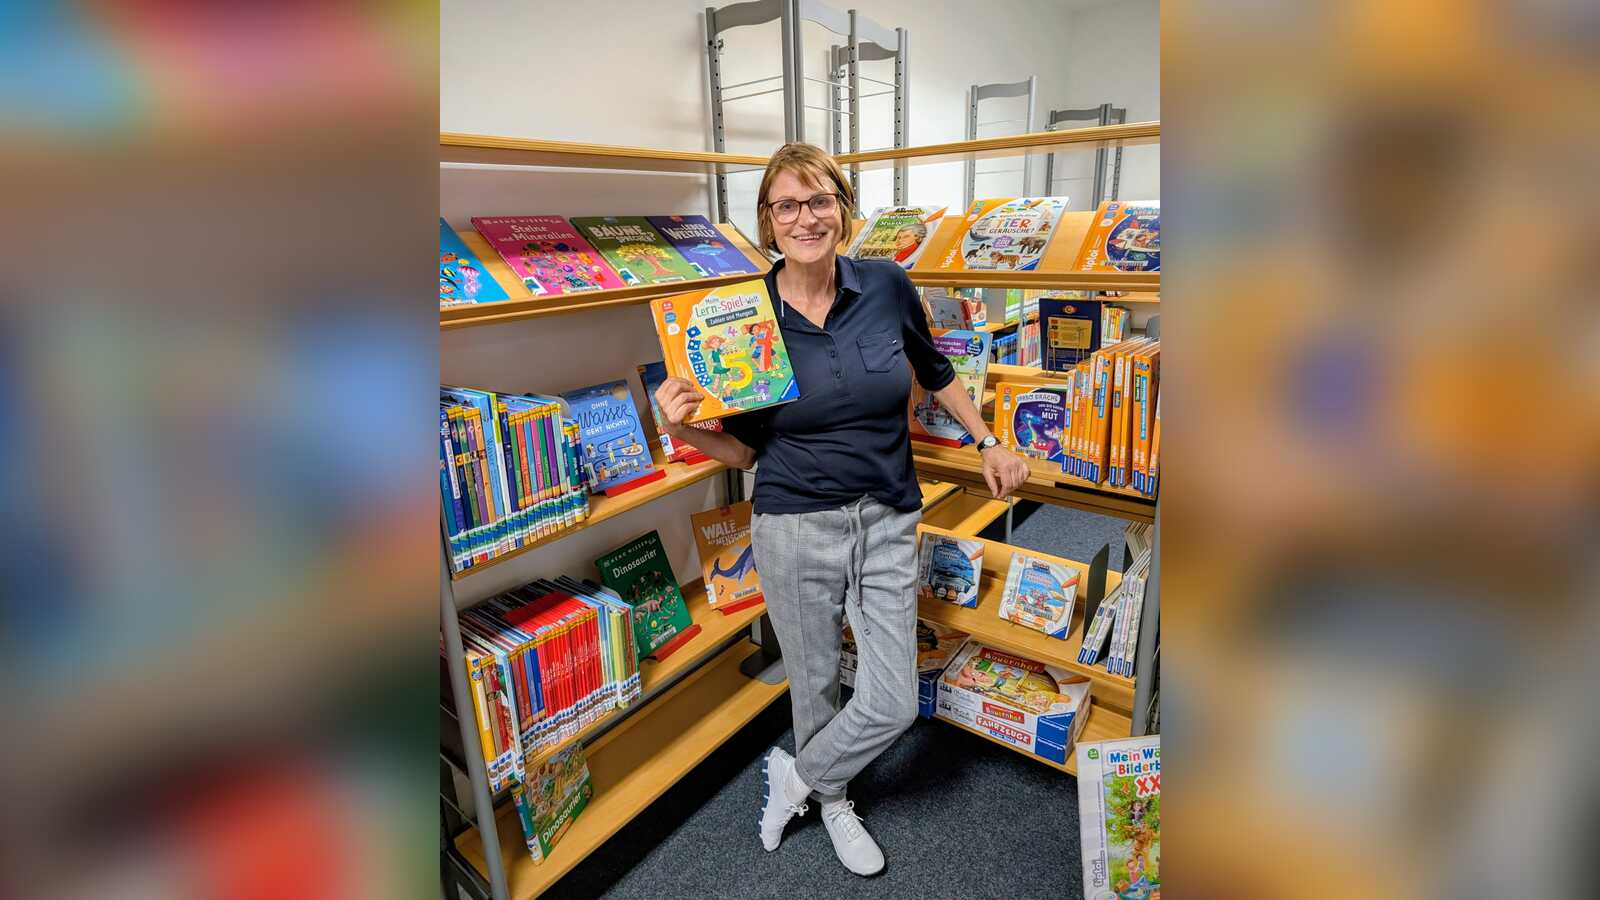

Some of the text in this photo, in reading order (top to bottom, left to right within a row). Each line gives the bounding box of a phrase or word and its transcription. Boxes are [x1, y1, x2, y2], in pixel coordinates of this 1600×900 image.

[511, 225, 548, 233] Steine
[512, 231, 576, 240] Mineralien
[721, 351, 753, 390] 5
[591, 400, 608, 409] OHNE
[578, 405, 628, 429] Wasser
[1041, 411, 1059, 421] MUT
[586, 426, 604, 436] GEHT
[702, 520, 737, 540] WALE
[612, 549, 658, 579] Dinosaurier
[984, 651, 1042, 673] Bauernhof
[977, 715, 1031, 745] FAHRZEUGE
[1110, 750, 1140, 764] Mein
[542, 791, 582, 844] Dinosaurier
[1093, 859, 1104, 888] tiptoi
